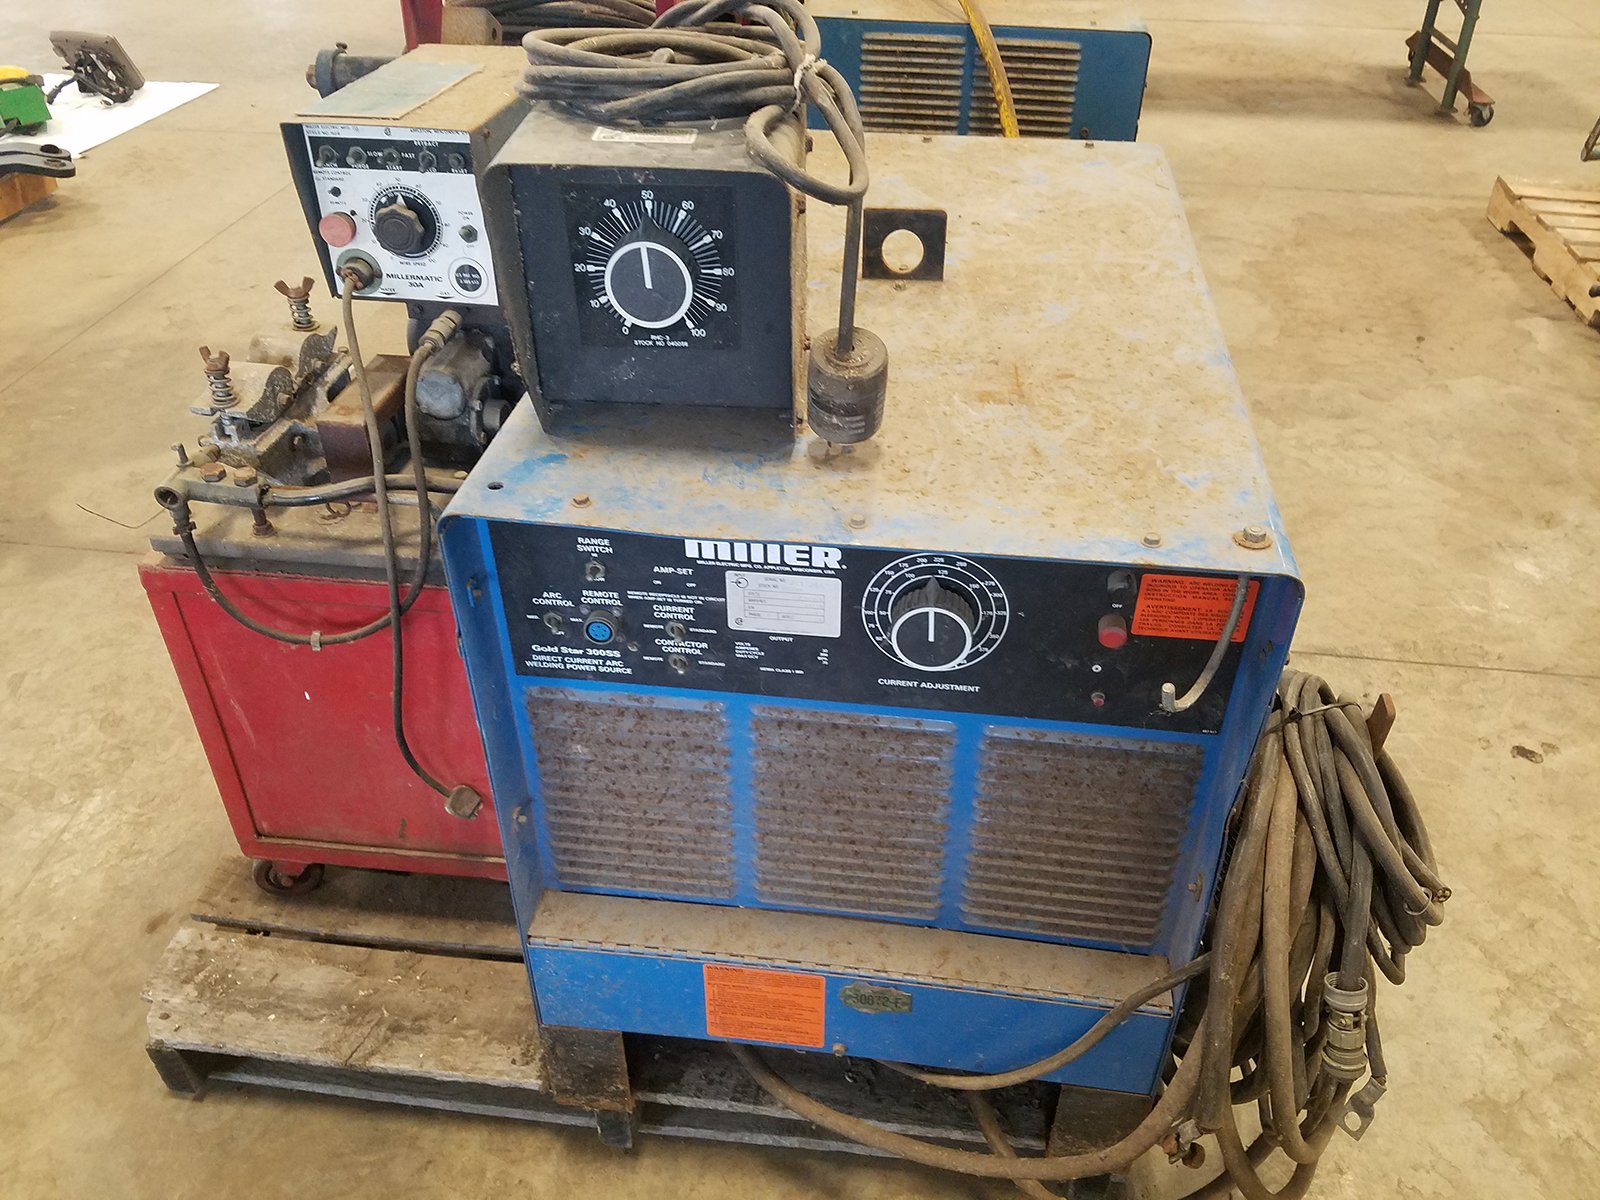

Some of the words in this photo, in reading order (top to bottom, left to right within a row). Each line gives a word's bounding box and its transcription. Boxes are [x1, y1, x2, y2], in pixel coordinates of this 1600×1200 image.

[641, 190, 654, 200] 50
[604, 198, 616, 208] 40
[682, 200, 694, 210] 60
[578, 226, 592, 236] 30
[710, 230, 724, 240] 70
[574, 264, 586, 272] 20
[722, 268, 735, 276] 80
[386, 272, 444, 282] MILLERMATIC
[590, 299, 600, 308] 10
[715, 303, 728, 312] 90
[690, 328, 706, 338] 100
[577, 537, 610, 546] RANGE
[576, 544, 614, 554] SWITCH
[653, 566, 694, 576] AMP-SET
[582, 590, 619, 599] REMOTE
[532, 598, 576, 608] CONTROL
[580, 597, 624, 607] CONTROL
[653, 604, 695, 614] CURRENT
[654, 612, 696, 622] CONTROL
[654, 638, 708, 649] CONTACTOR
[531, 644, 558, 653] Gold
[560, 646, 584, 655] Star
[586, 648, 622, 658] 300SS
[662, 646, 703, 656] CONTROL
[564, 656, 603, 666] CURRENT
[525, 660, 564, 670] WELDING
[566, 664, 597, 672] POWER
[598, 666, 633, 675] SOURCE
[878, 678, 918, 688] CURRENT
[920, 681, 980, 692] ADJUSTMENT
